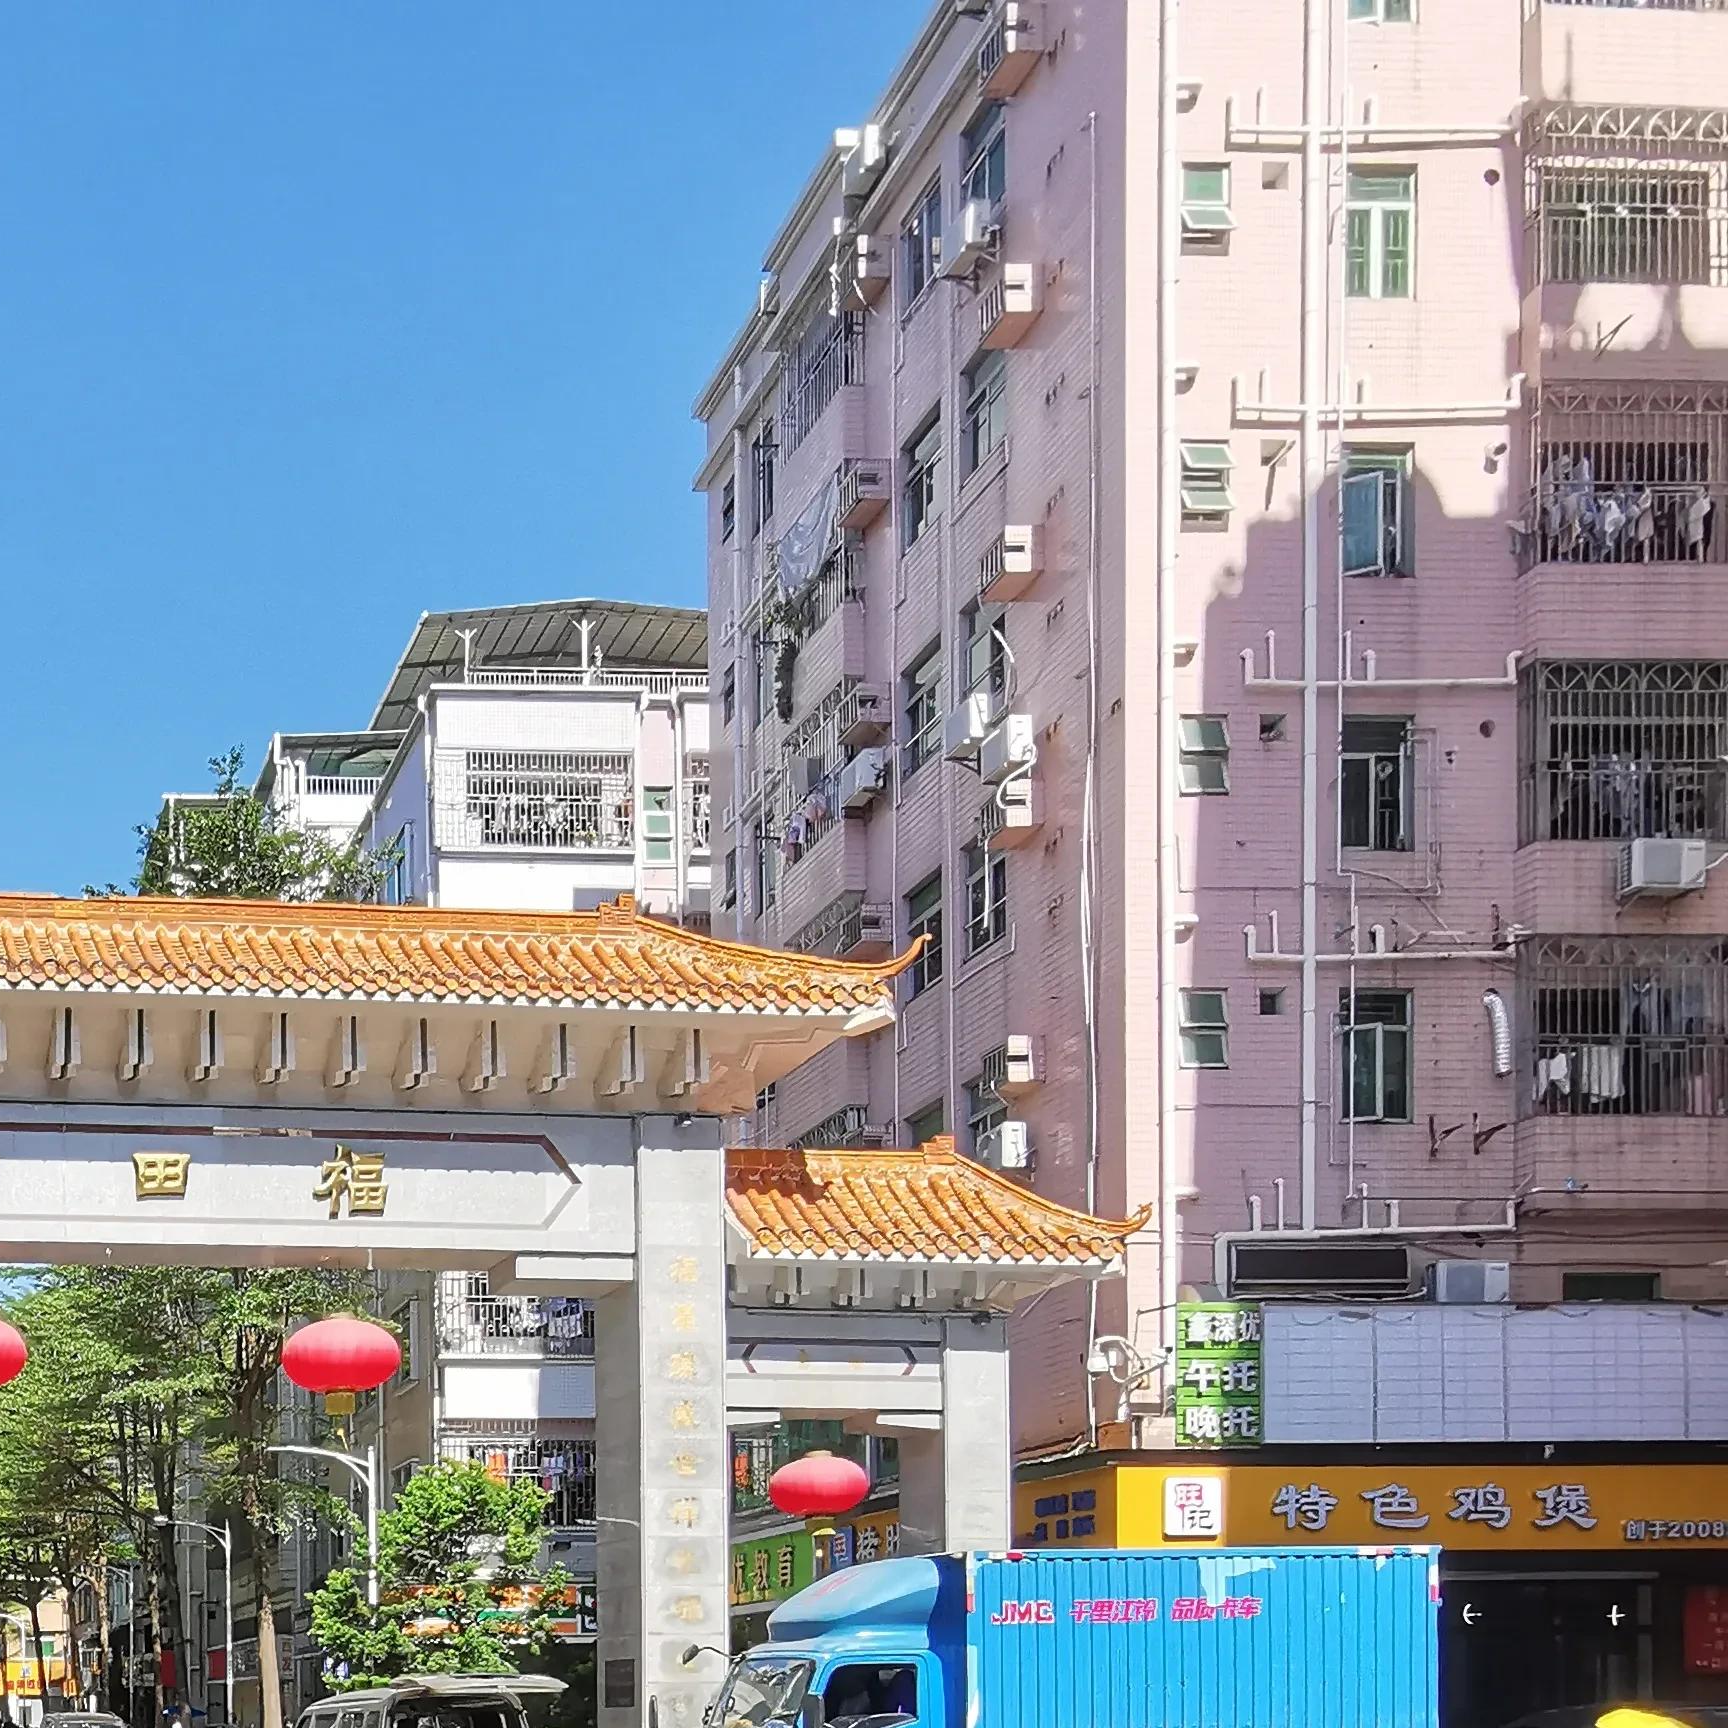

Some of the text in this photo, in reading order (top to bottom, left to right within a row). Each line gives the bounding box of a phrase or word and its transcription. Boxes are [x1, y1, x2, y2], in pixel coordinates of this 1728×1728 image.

[1185, 1359, 1257, 1392] 午托
[1185, 1405, 1258, 1439] 晚托
[1174, 1483, 1214, 1531] 旺记
[1271, 1484, 1599, 1531] 特色鸡煲
[1626, 1520, 1725, 1540] 创于2008
[991, 1600, 1055, 1625] JMC
[1070, 1597, 1159, 1624] 千里江铃
